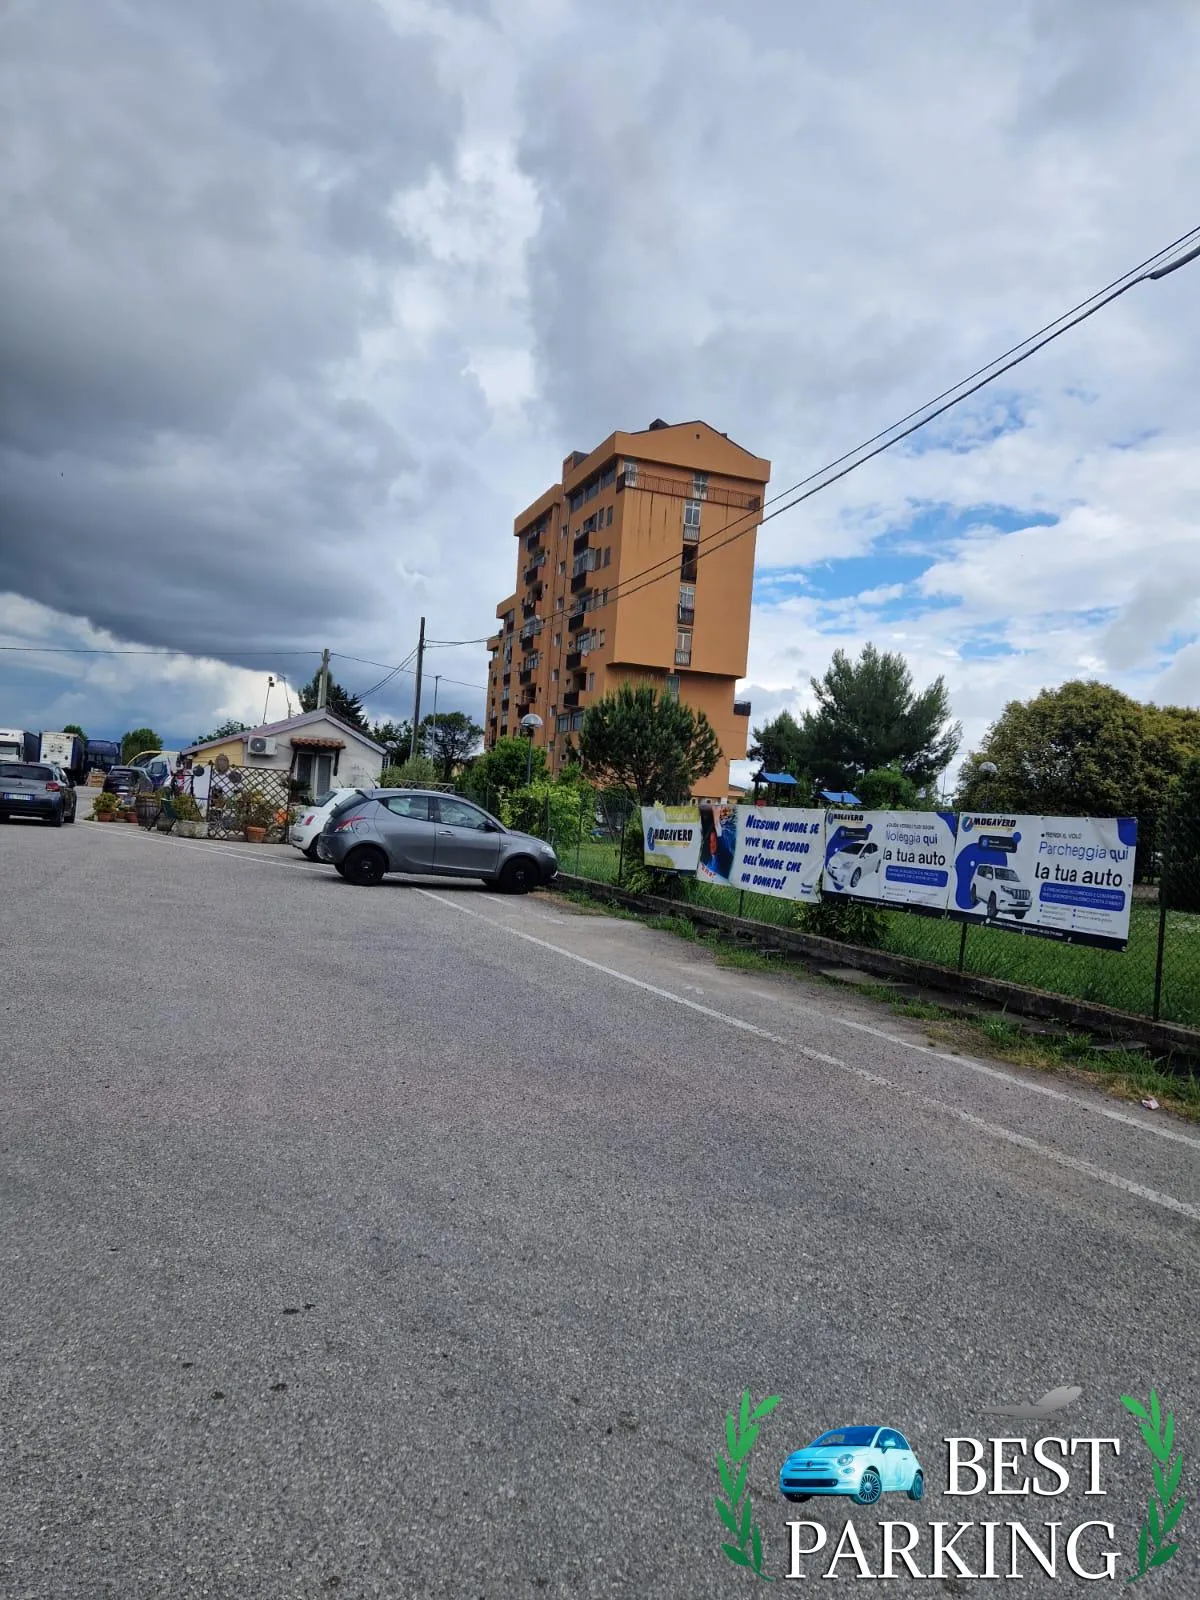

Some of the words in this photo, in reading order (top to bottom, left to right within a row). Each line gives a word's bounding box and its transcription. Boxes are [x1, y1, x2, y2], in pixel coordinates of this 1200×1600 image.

[810, 823, 820, 834] SE
[974, 817, 1016, 827] MOGAVERO
[745, 837, 760, 847] VIVE
[762, 839, 775, 850] NEL
[777, 841, 810, 853] RICORDO
[923, 834, 937, 846] qui
[883, 848, 892, 860] la
[897, 848, 915, 863] tua
[918, 851, 946, 866] auto
[1039, 841, 1106, 861] Parcheggia
[1110, 847, 1128, 863] qui
[786, 861, 802, 872] CHE
[1035, 862, 1050, 879] la
[1055, 864, 1077, 882] tua
[1082, 868, 1123, 887] auto
[741, 873, 751, 883] HA
[753, 874, 787, 889] DONATO!
